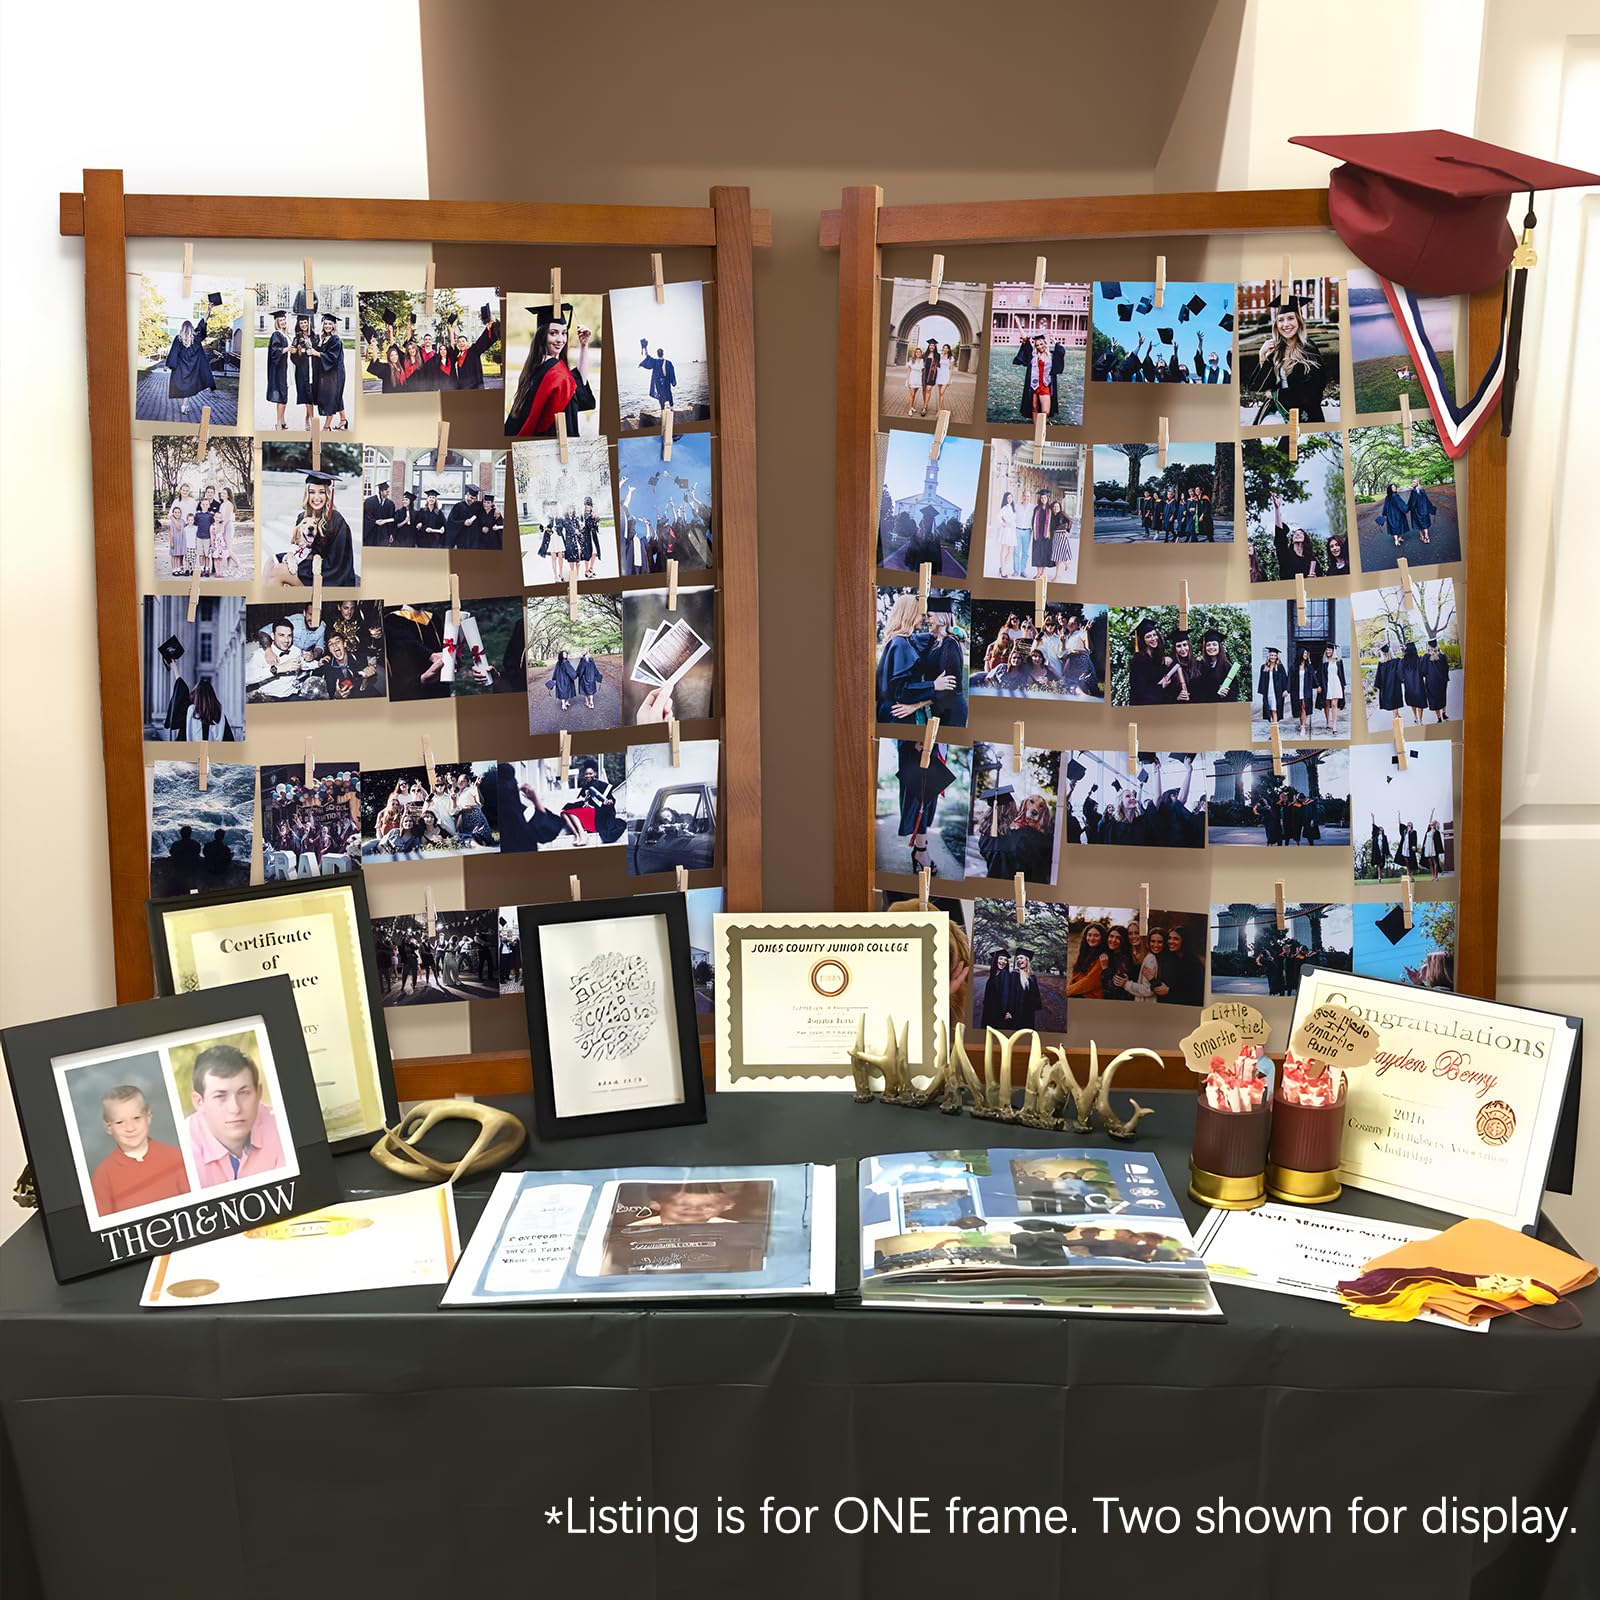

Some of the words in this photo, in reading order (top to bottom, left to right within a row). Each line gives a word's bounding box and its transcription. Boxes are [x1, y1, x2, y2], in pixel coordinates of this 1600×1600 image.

[219, 929, 312, 954] Certificate
[785, 943, 826, 953] COUNTY
[827, 943, 865, 953] JUNIOR
[866, 942, 910, 953] COLLEGE
[261, 954, 280, 971] of
[1211, 1004, 1248, 1020] Little
[1373, 1048, 1428, 1078] ayden
[1432, 1049, 1499, 1099] Berry
